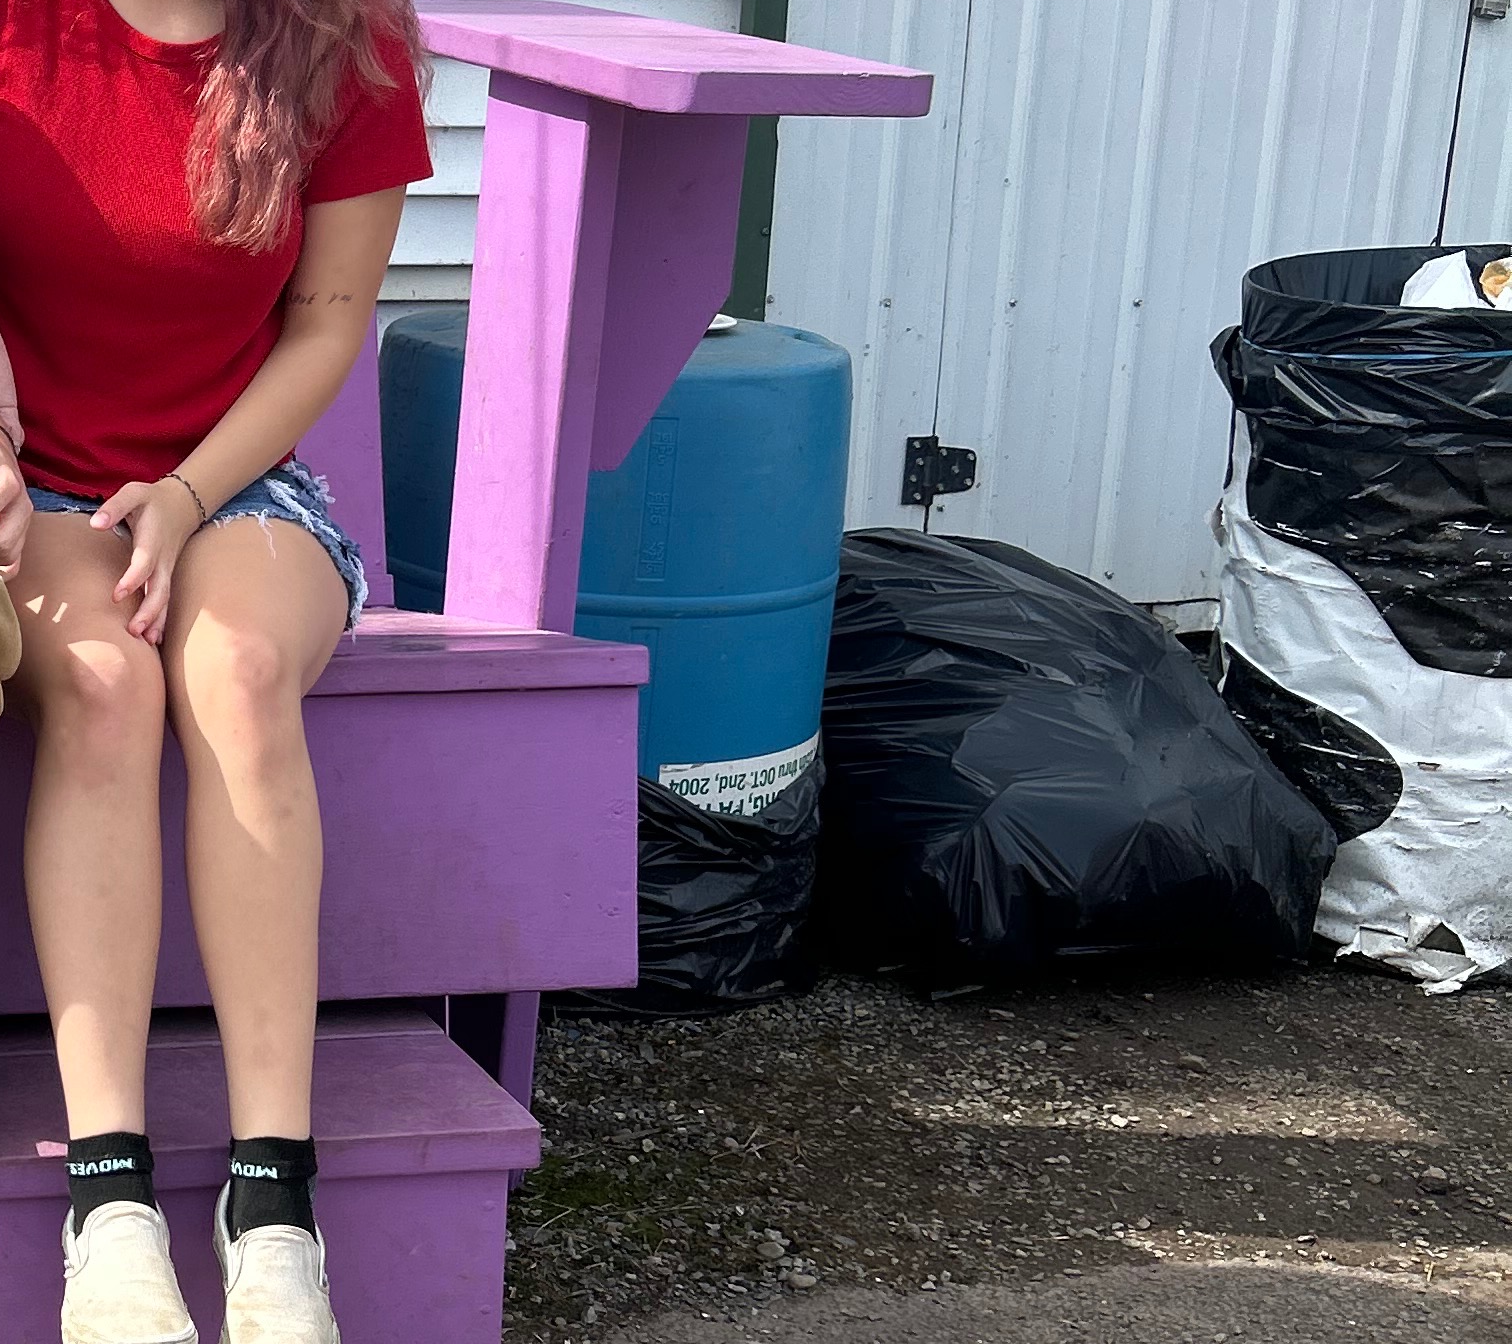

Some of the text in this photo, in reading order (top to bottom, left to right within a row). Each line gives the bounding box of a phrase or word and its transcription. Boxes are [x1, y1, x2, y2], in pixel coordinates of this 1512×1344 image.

[750, 767, 776, 789] OCT.
[778, 759, 798, 778] thru
[669, 778, 710, 796] 2004
[715, 773, 747, 793] 2nd,
